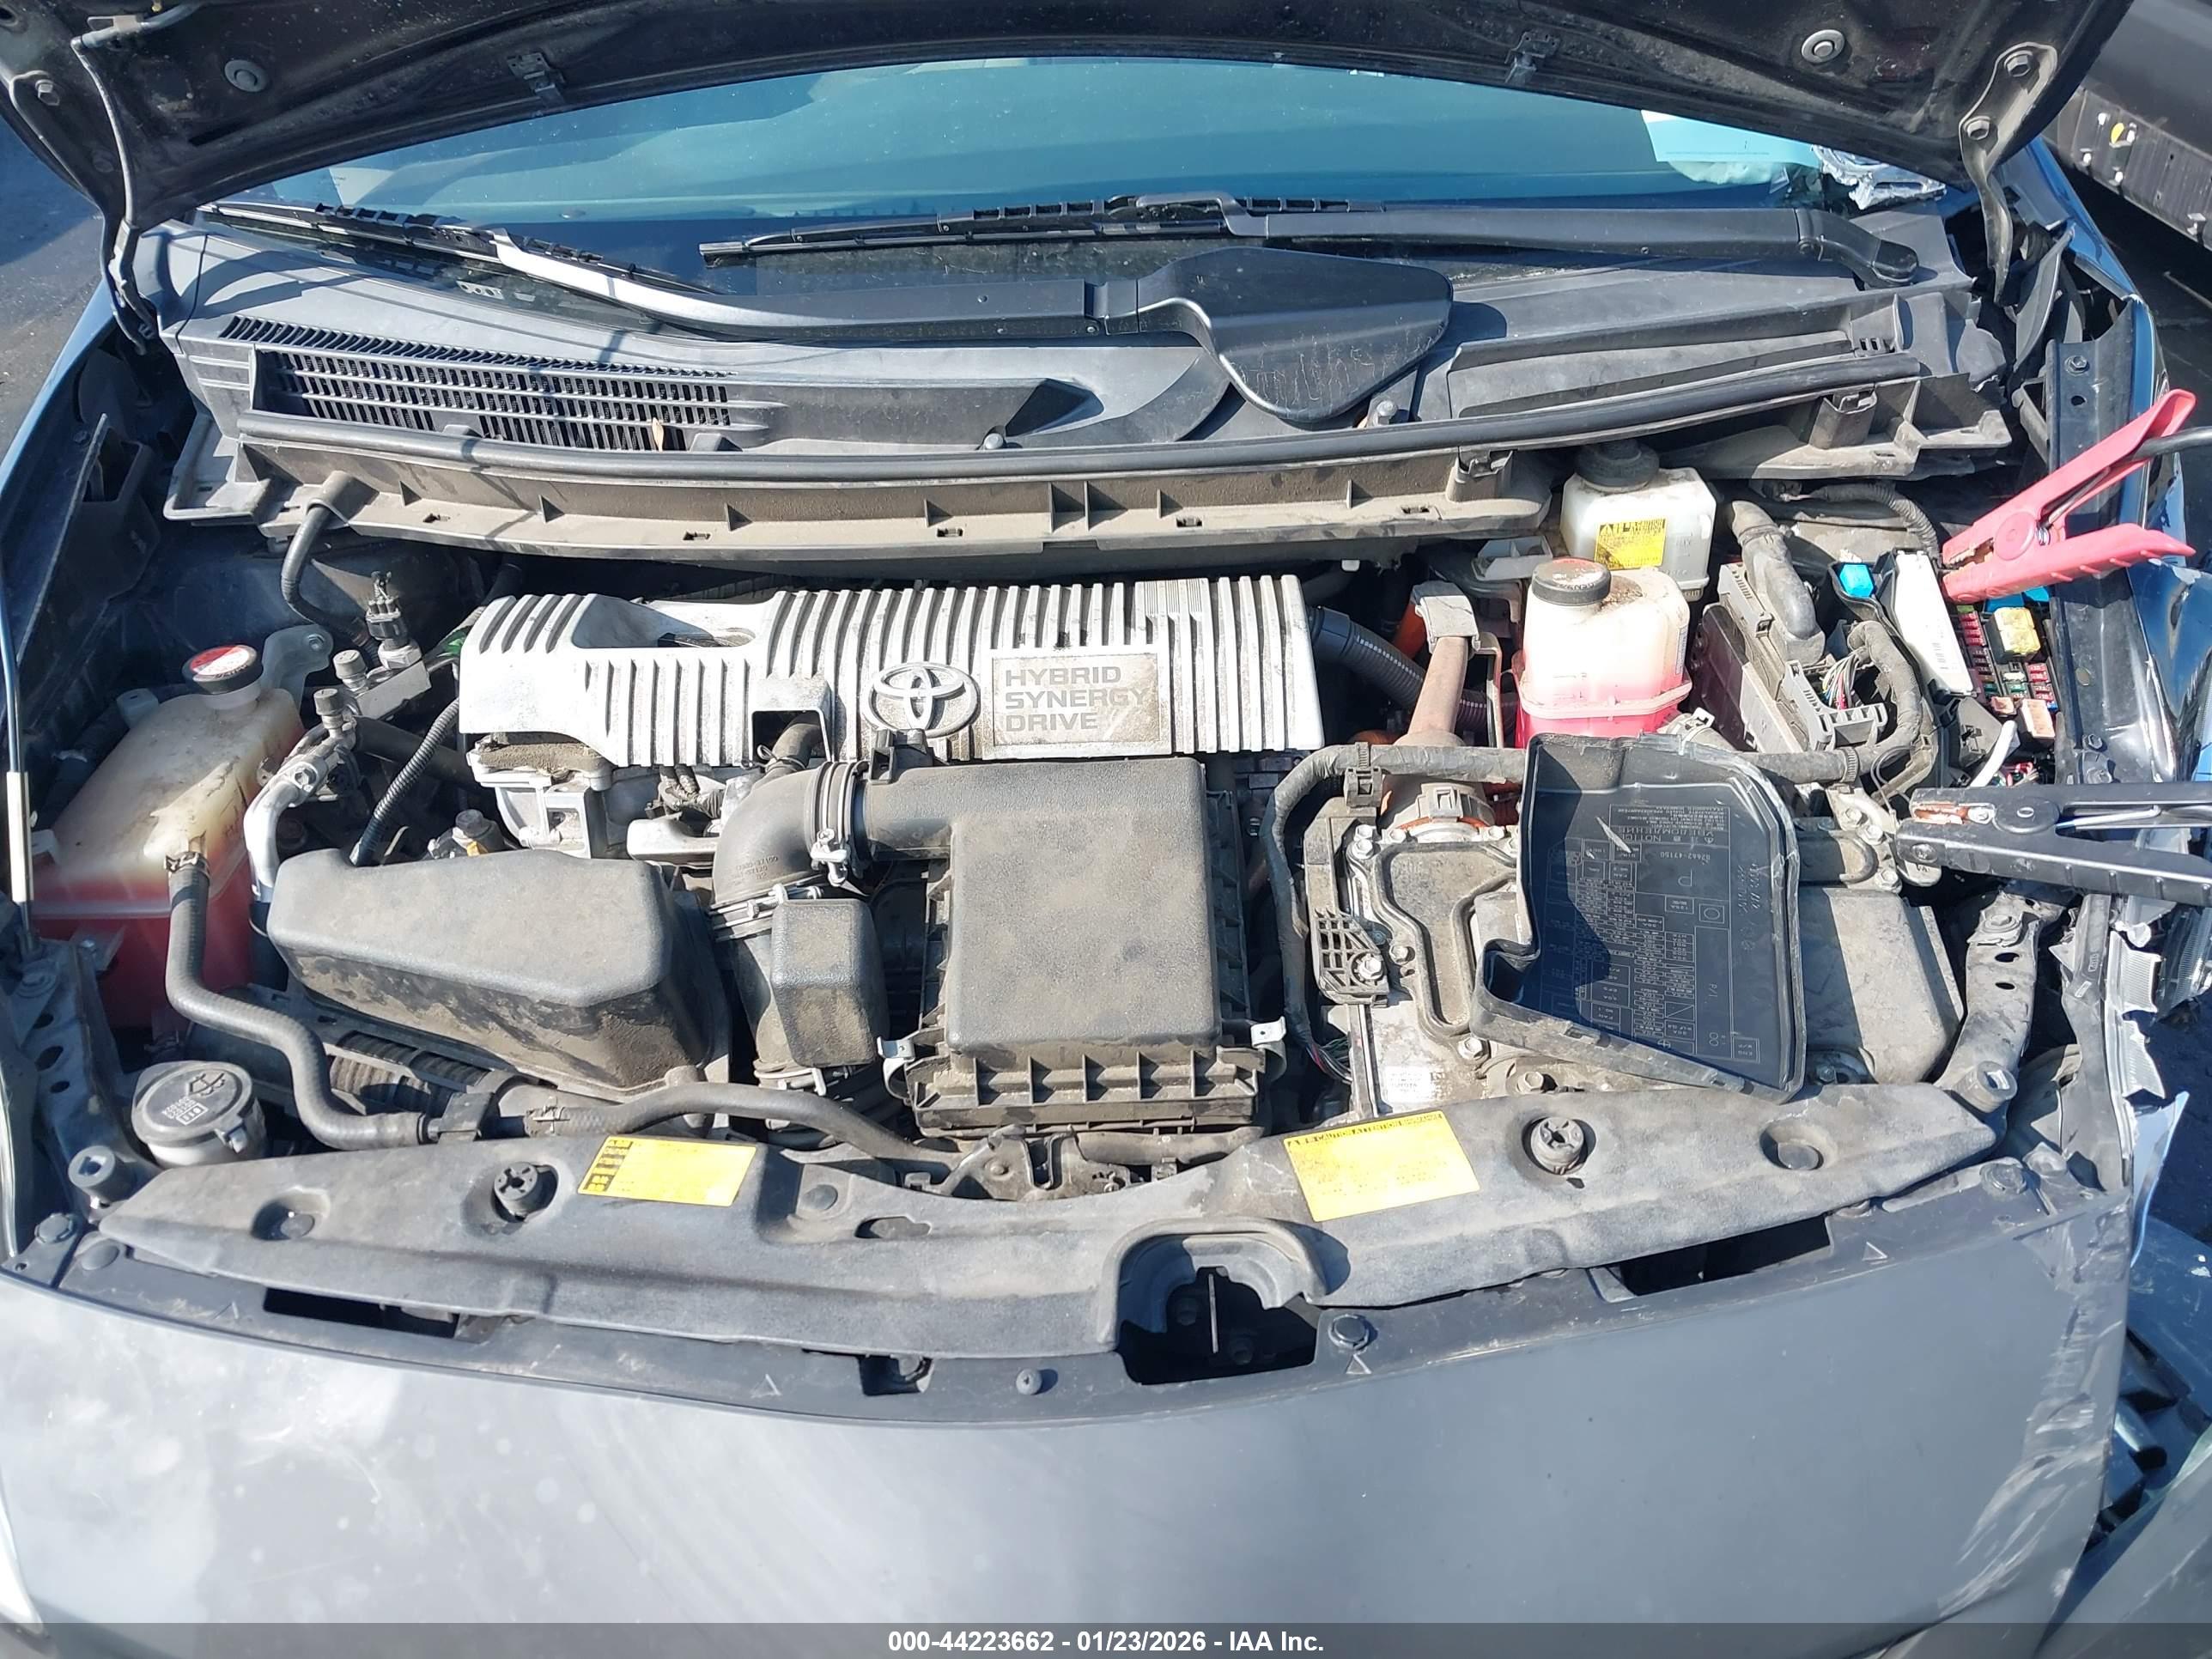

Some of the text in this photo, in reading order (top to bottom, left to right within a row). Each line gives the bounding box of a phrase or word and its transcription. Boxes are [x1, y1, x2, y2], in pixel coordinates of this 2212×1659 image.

[1006, 666, 1121, 687] HYBRID
[1005, 688, 1148, 709] SYNERGY
[1006, 712, 1098, 732] DRIVE
